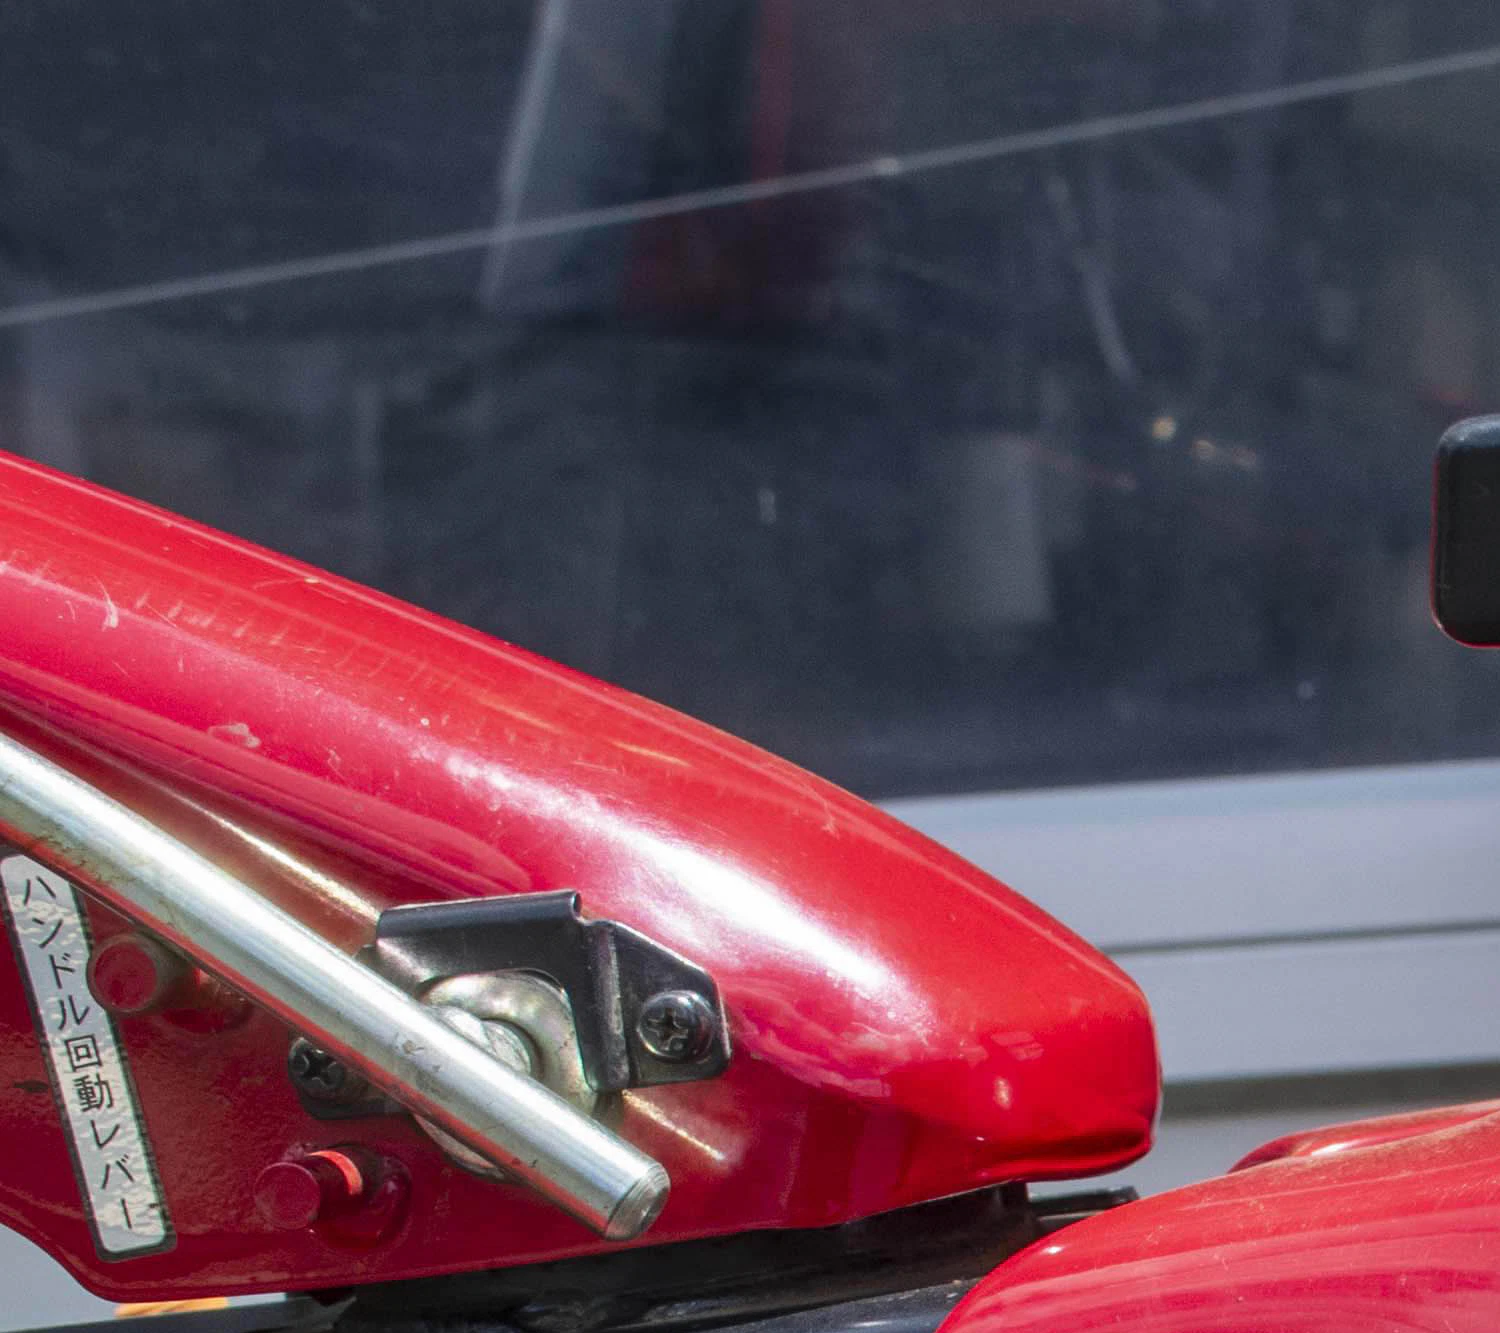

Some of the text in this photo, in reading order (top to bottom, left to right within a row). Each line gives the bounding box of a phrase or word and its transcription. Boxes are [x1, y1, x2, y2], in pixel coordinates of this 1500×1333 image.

[23, 876, 134, 1229] ハンドル回動レバー
